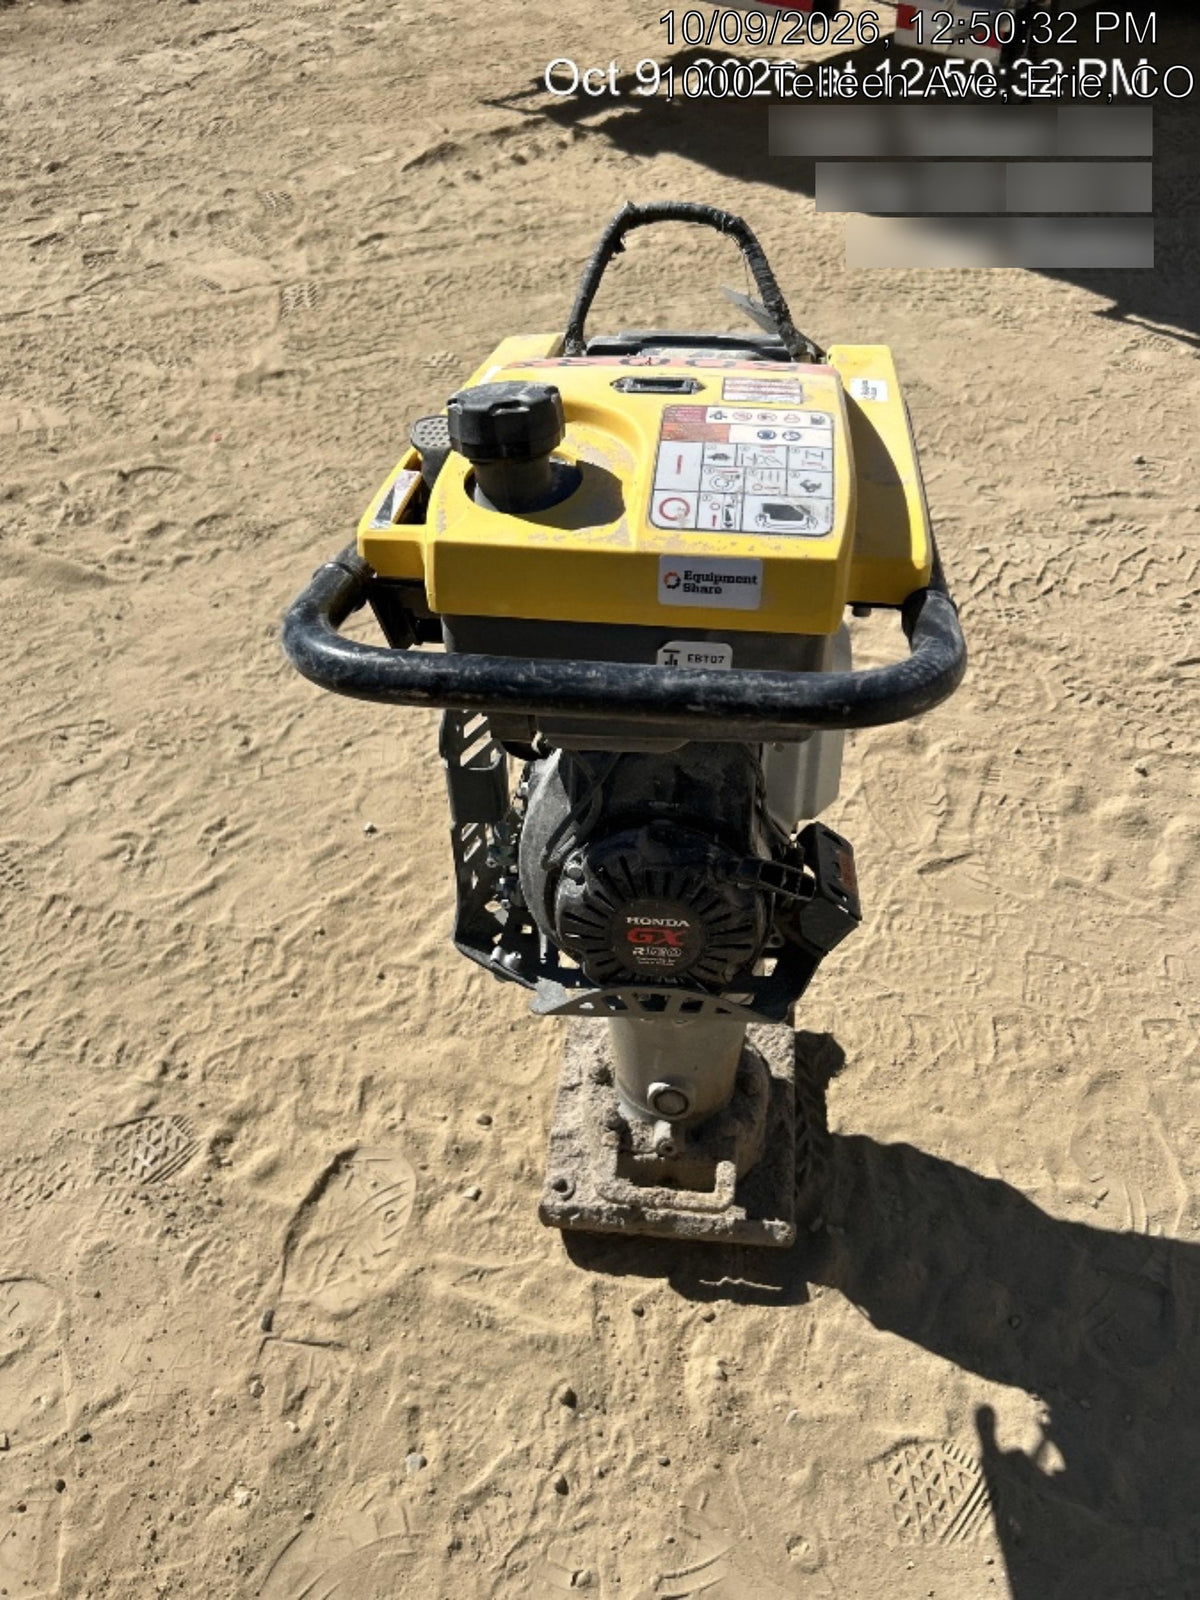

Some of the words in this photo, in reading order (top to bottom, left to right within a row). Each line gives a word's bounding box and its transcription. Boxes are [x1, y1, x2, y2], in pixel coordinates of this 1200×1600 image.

[683, 570, 758, 585] Equipment
[682, 583, 723, 595] Share
[626, 916, 690, 927] HONDA
[627, 927, 686, 946] GX
